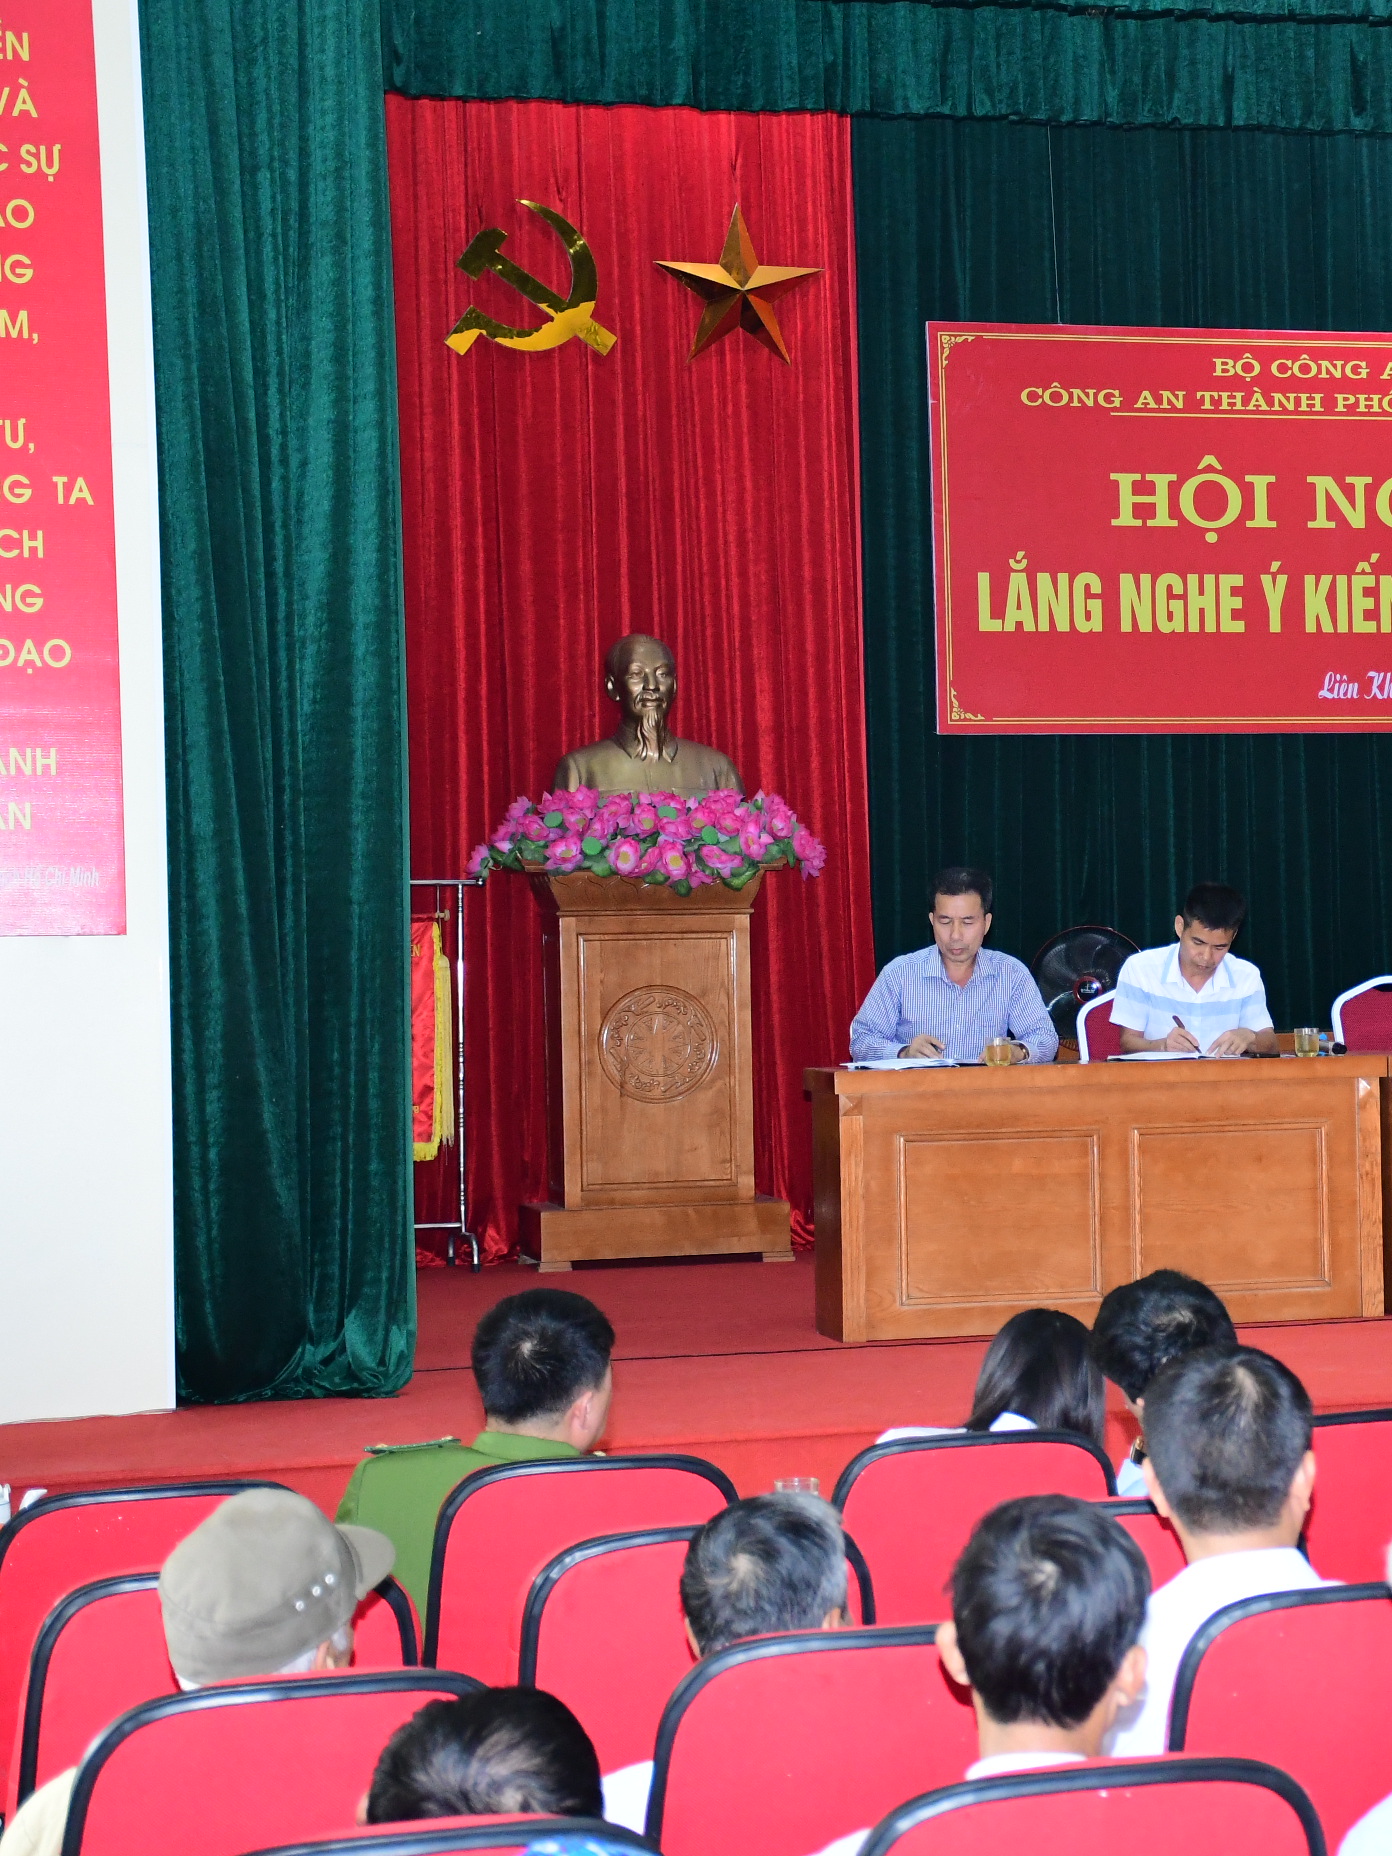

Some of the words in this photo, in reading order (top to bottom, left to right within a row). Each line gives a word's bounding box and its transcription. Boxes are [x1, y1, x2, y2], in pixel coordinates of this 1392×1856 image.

[0, 18, 30, 61] N
[20, 143, 62, 182] SỰ
[0, 198, 35, 229] O
[1213, 353, 1261, 381] BỘ
[1271, 353, 1371, 380] CÔNG
[1020, 382, 1124, 408] CÔNG
[1133, 390, 1187, 409] AN
[1196, 386, 1325, 412] THÀNH
[0, 417, 35, 454] Ư,
[52, 476, 95, 506] TA
[1109, 454, 1278, 544] HỘI
[977, 550, 1103, 634] LẮNG
[1119, 572, 1247, 634] NGHE
[1259, 560, 1289, 634] Ý
[1317, 671, 1360, 699] Liên
[0, 747, 57, 776] NH
[0, 801, 31, 830] N
[69, 865, 100, 887] Minh
